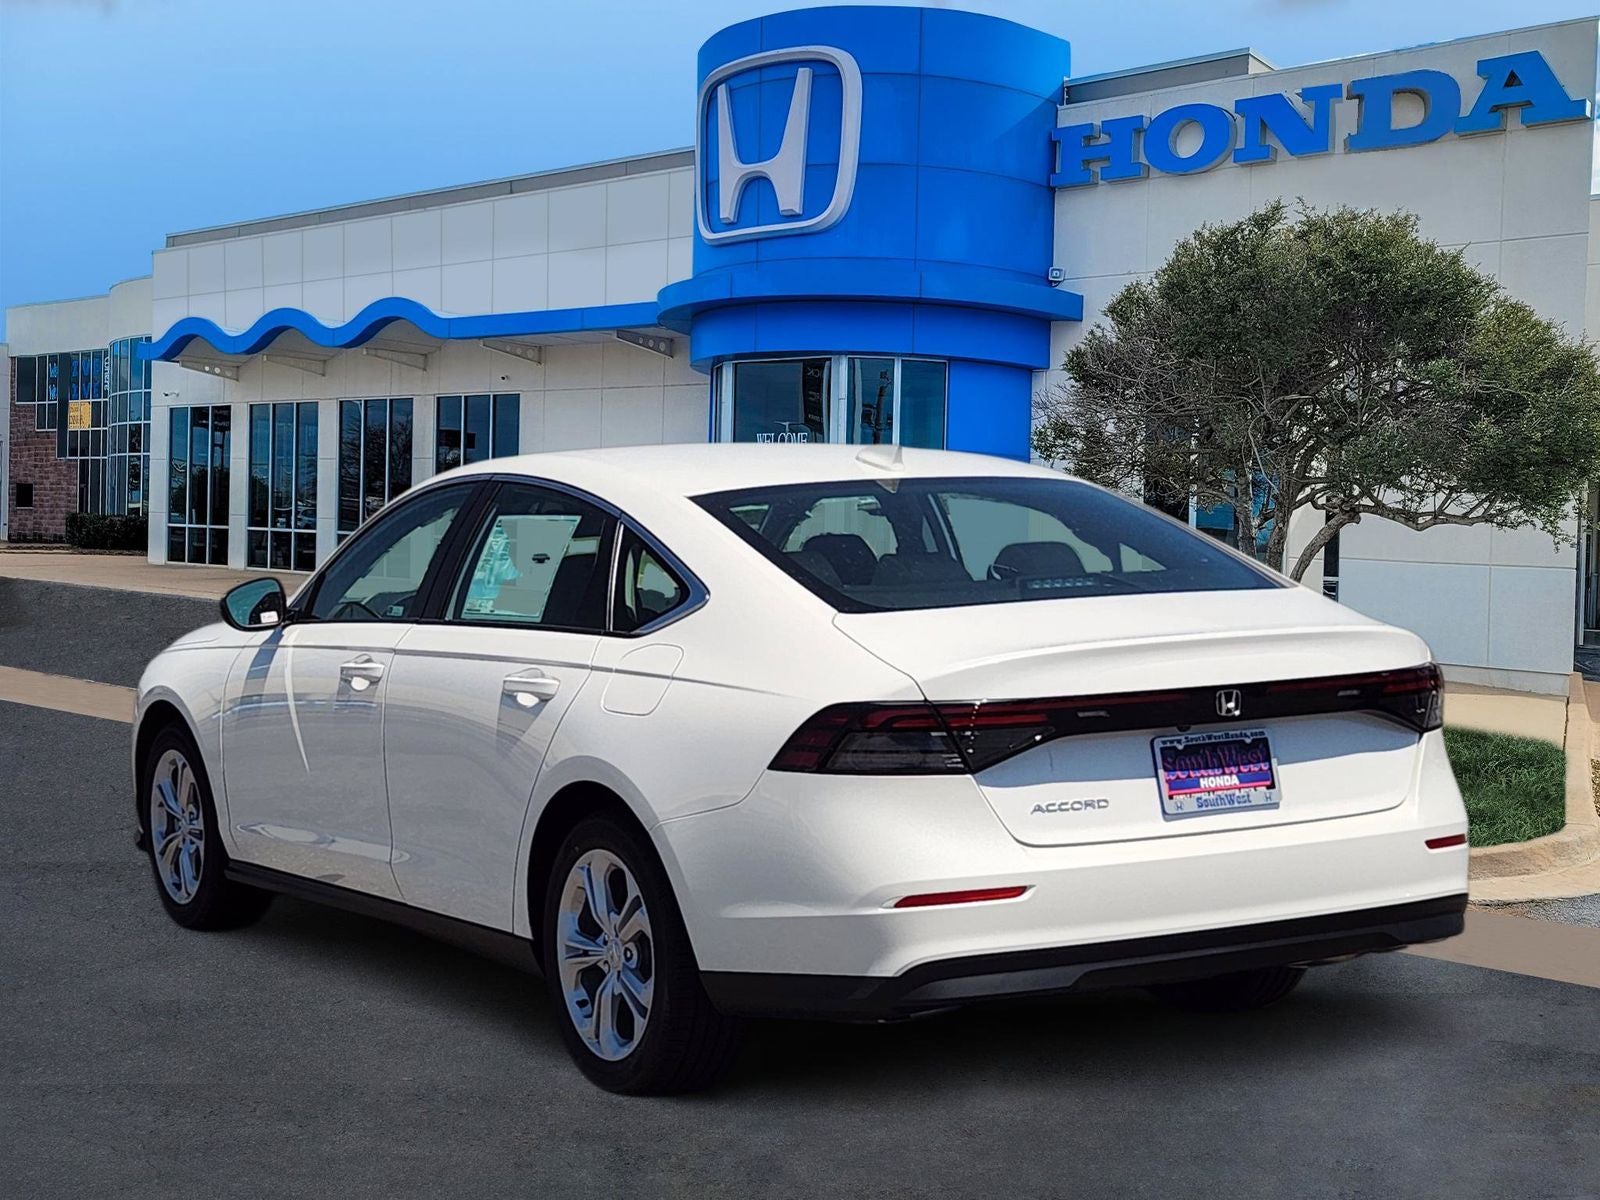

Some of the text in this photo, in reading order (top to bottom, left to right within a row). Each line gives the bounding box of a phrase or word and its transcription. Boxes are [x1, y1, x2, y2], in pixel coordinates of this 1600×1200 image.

[1050, 50, 1591, 187] HONDA
[1199, 774, 1240, 788] HONDA
[1030, 799, 1109, 815] ACCORD
